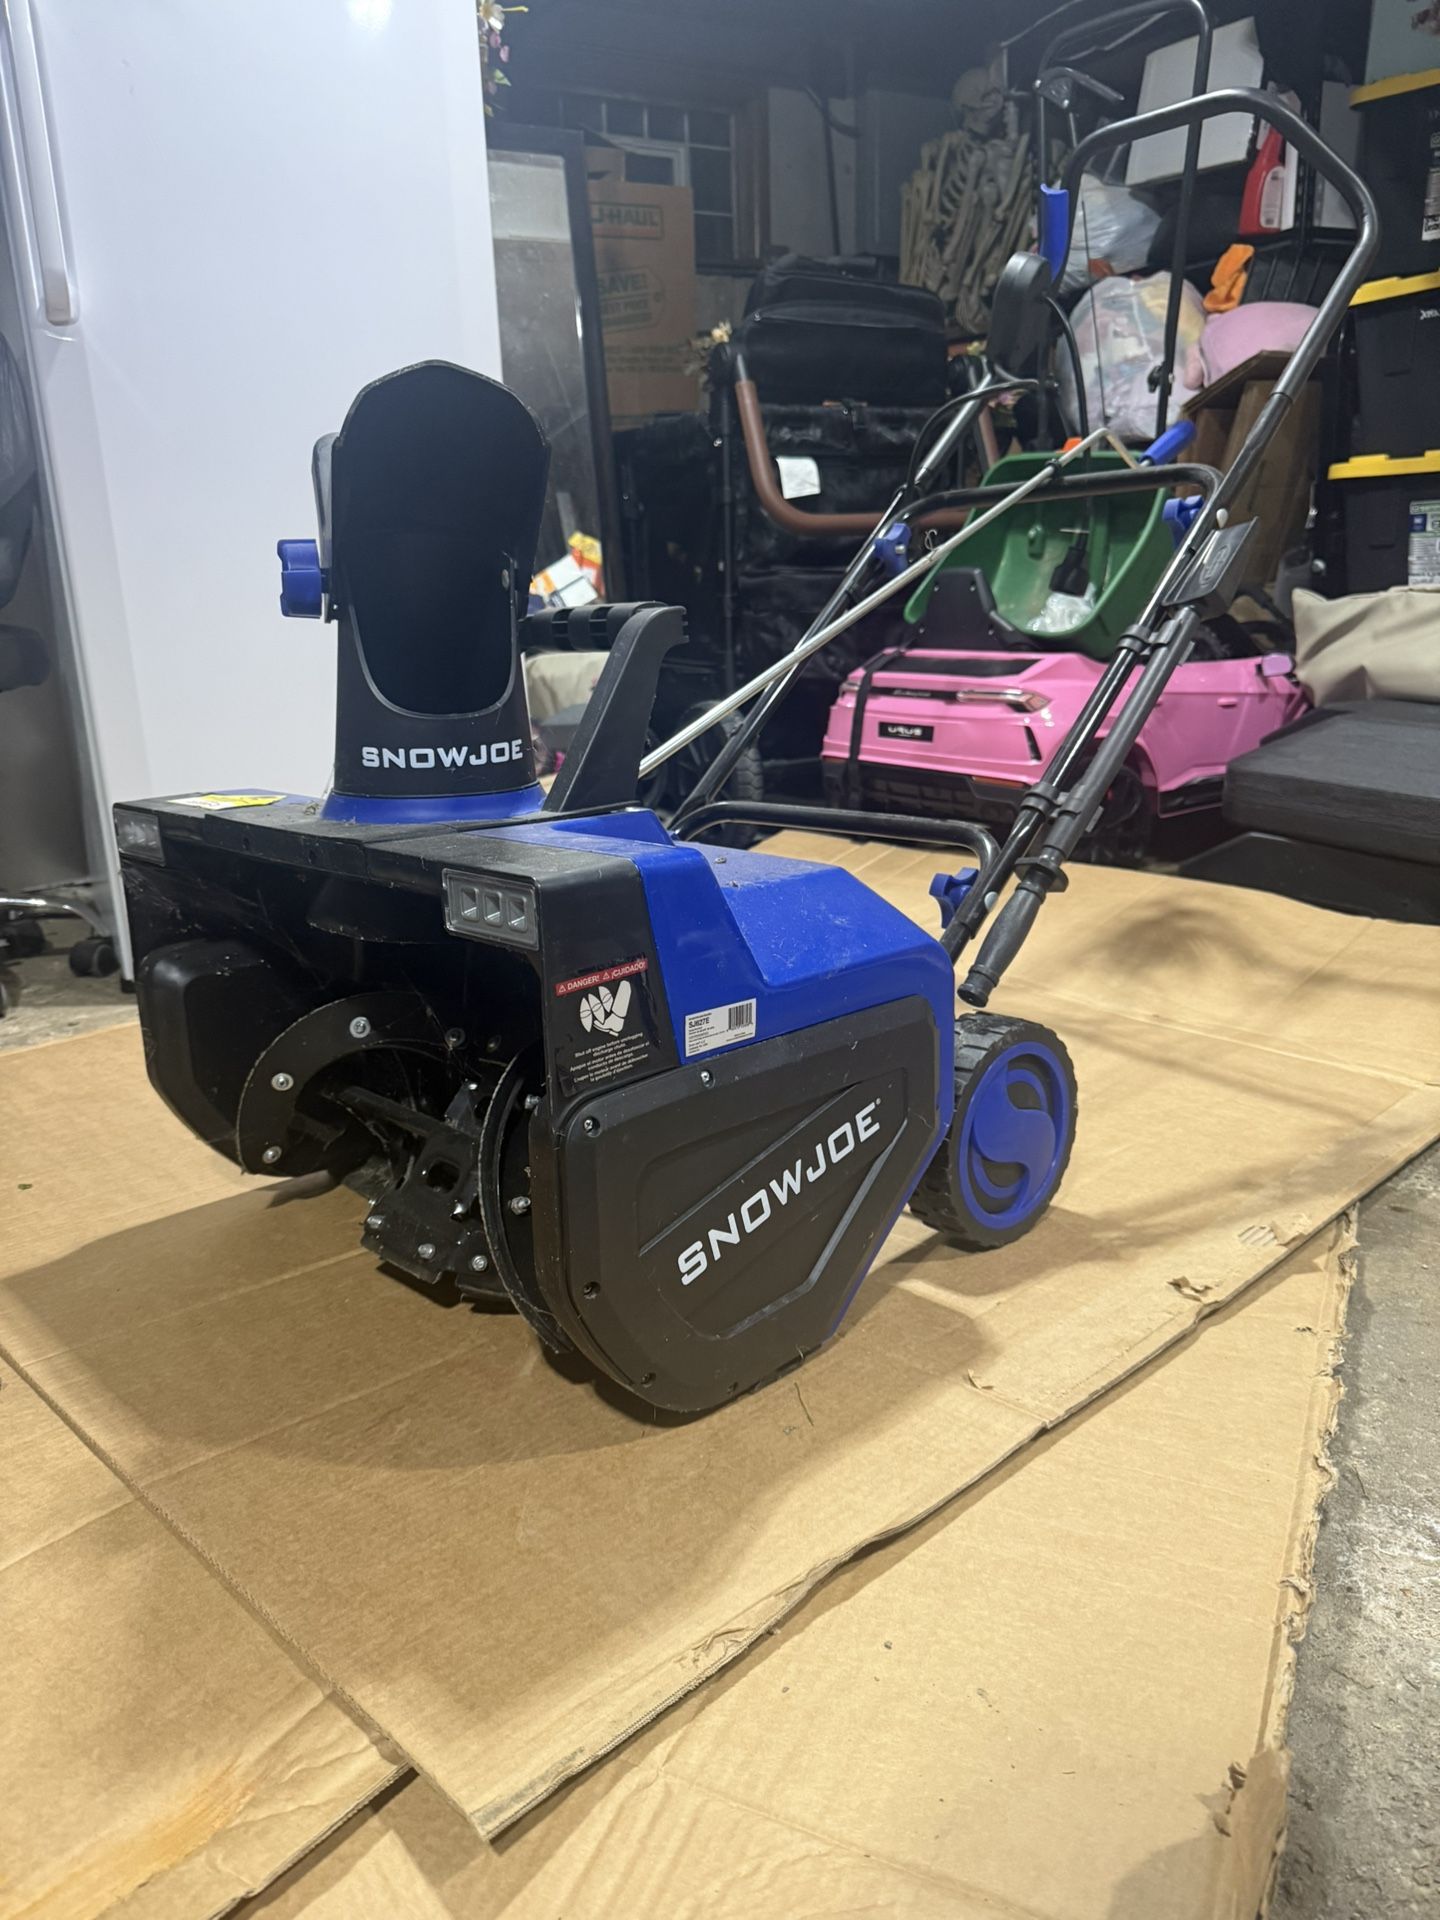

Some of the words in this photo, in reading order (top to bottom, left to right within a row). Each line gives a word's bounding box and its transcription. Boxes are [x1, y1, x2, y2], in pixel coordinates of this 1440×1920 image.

[362, 739, 523, 768] SNOWJOE
[567, 974, 600, 990] DANGER!
[678, 1100, 881, 1286] SNOWJOE
